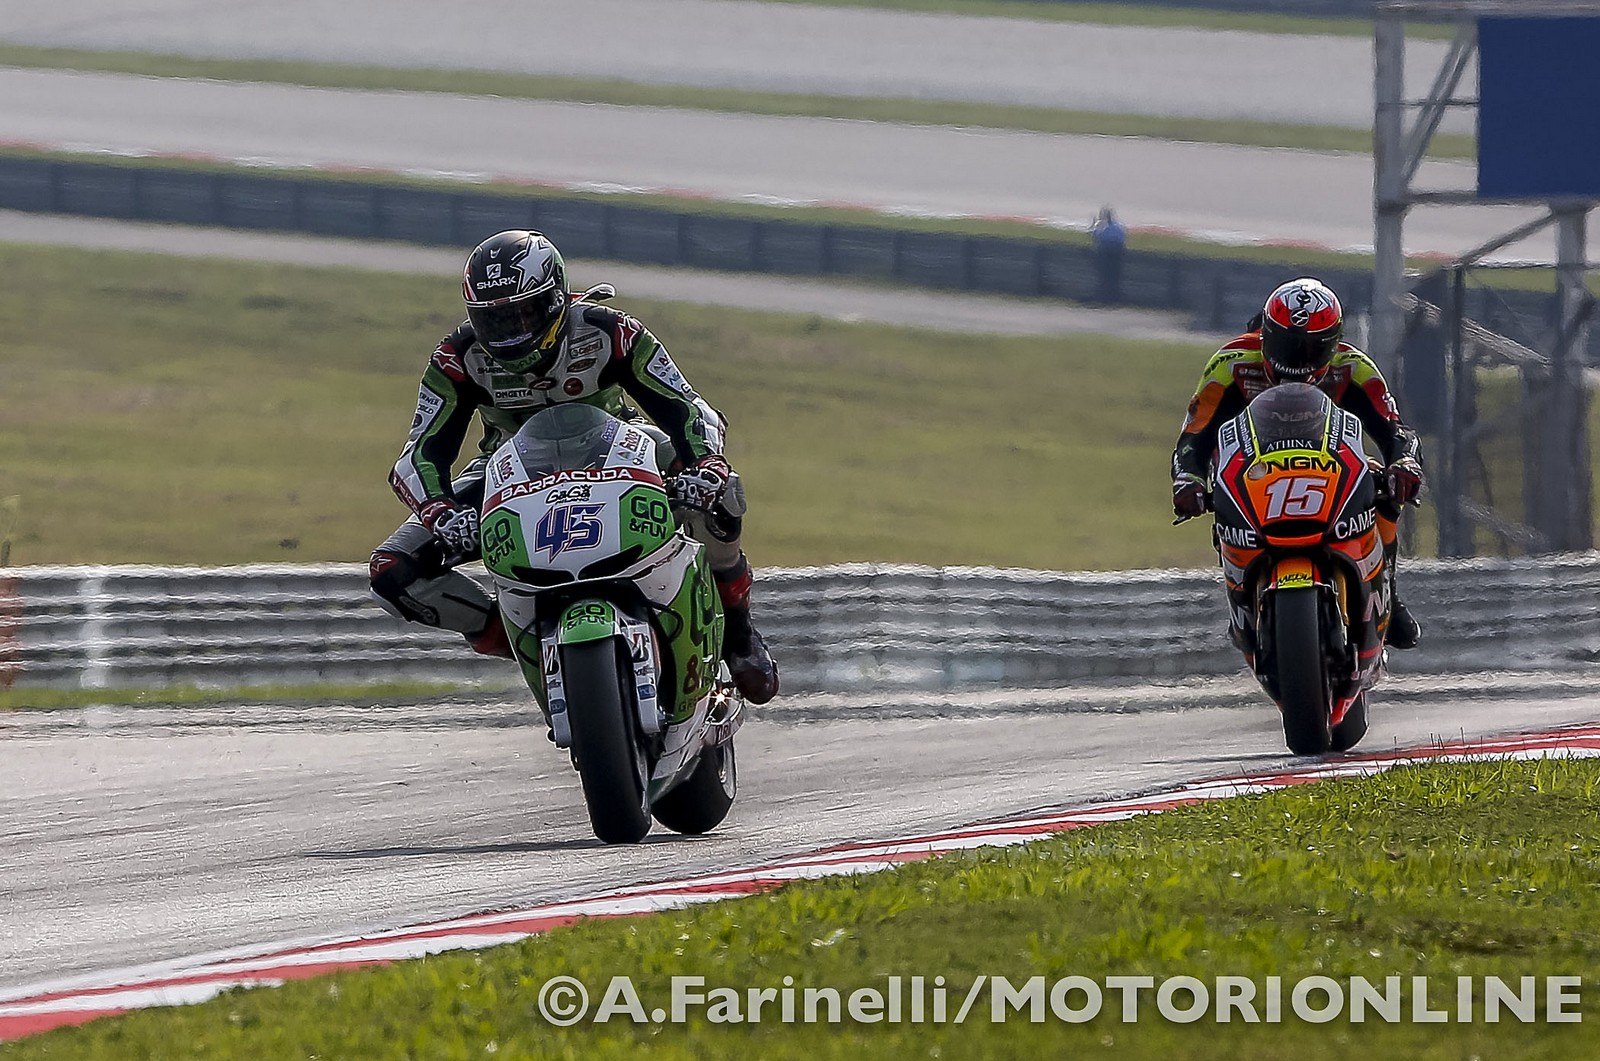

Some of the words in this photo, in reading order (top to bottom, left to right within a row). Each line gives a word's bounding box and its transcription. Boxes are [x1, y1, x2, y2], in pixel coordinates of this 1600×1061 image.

[477, 276, 517, 290] SHARK
[1267, 457, 1337, 474] NGM
[501, 468, 633, 501] BARRACUDA
[1265, 477, 1328, 520] 15
[631, 495, 667, 524] GO
[1334, 506, 1377, 540] CAME
[483, 519, 511, 554] GO
[535, 503, 607, 565] 45
[629, 518, 667, 540] &FUN
[1215, 522, 1258, 548] CAME
[488, 538, 516, 567] &FUN
[566, 604, 606, 621] GO
[566, 615, 606, 631] &FUN
